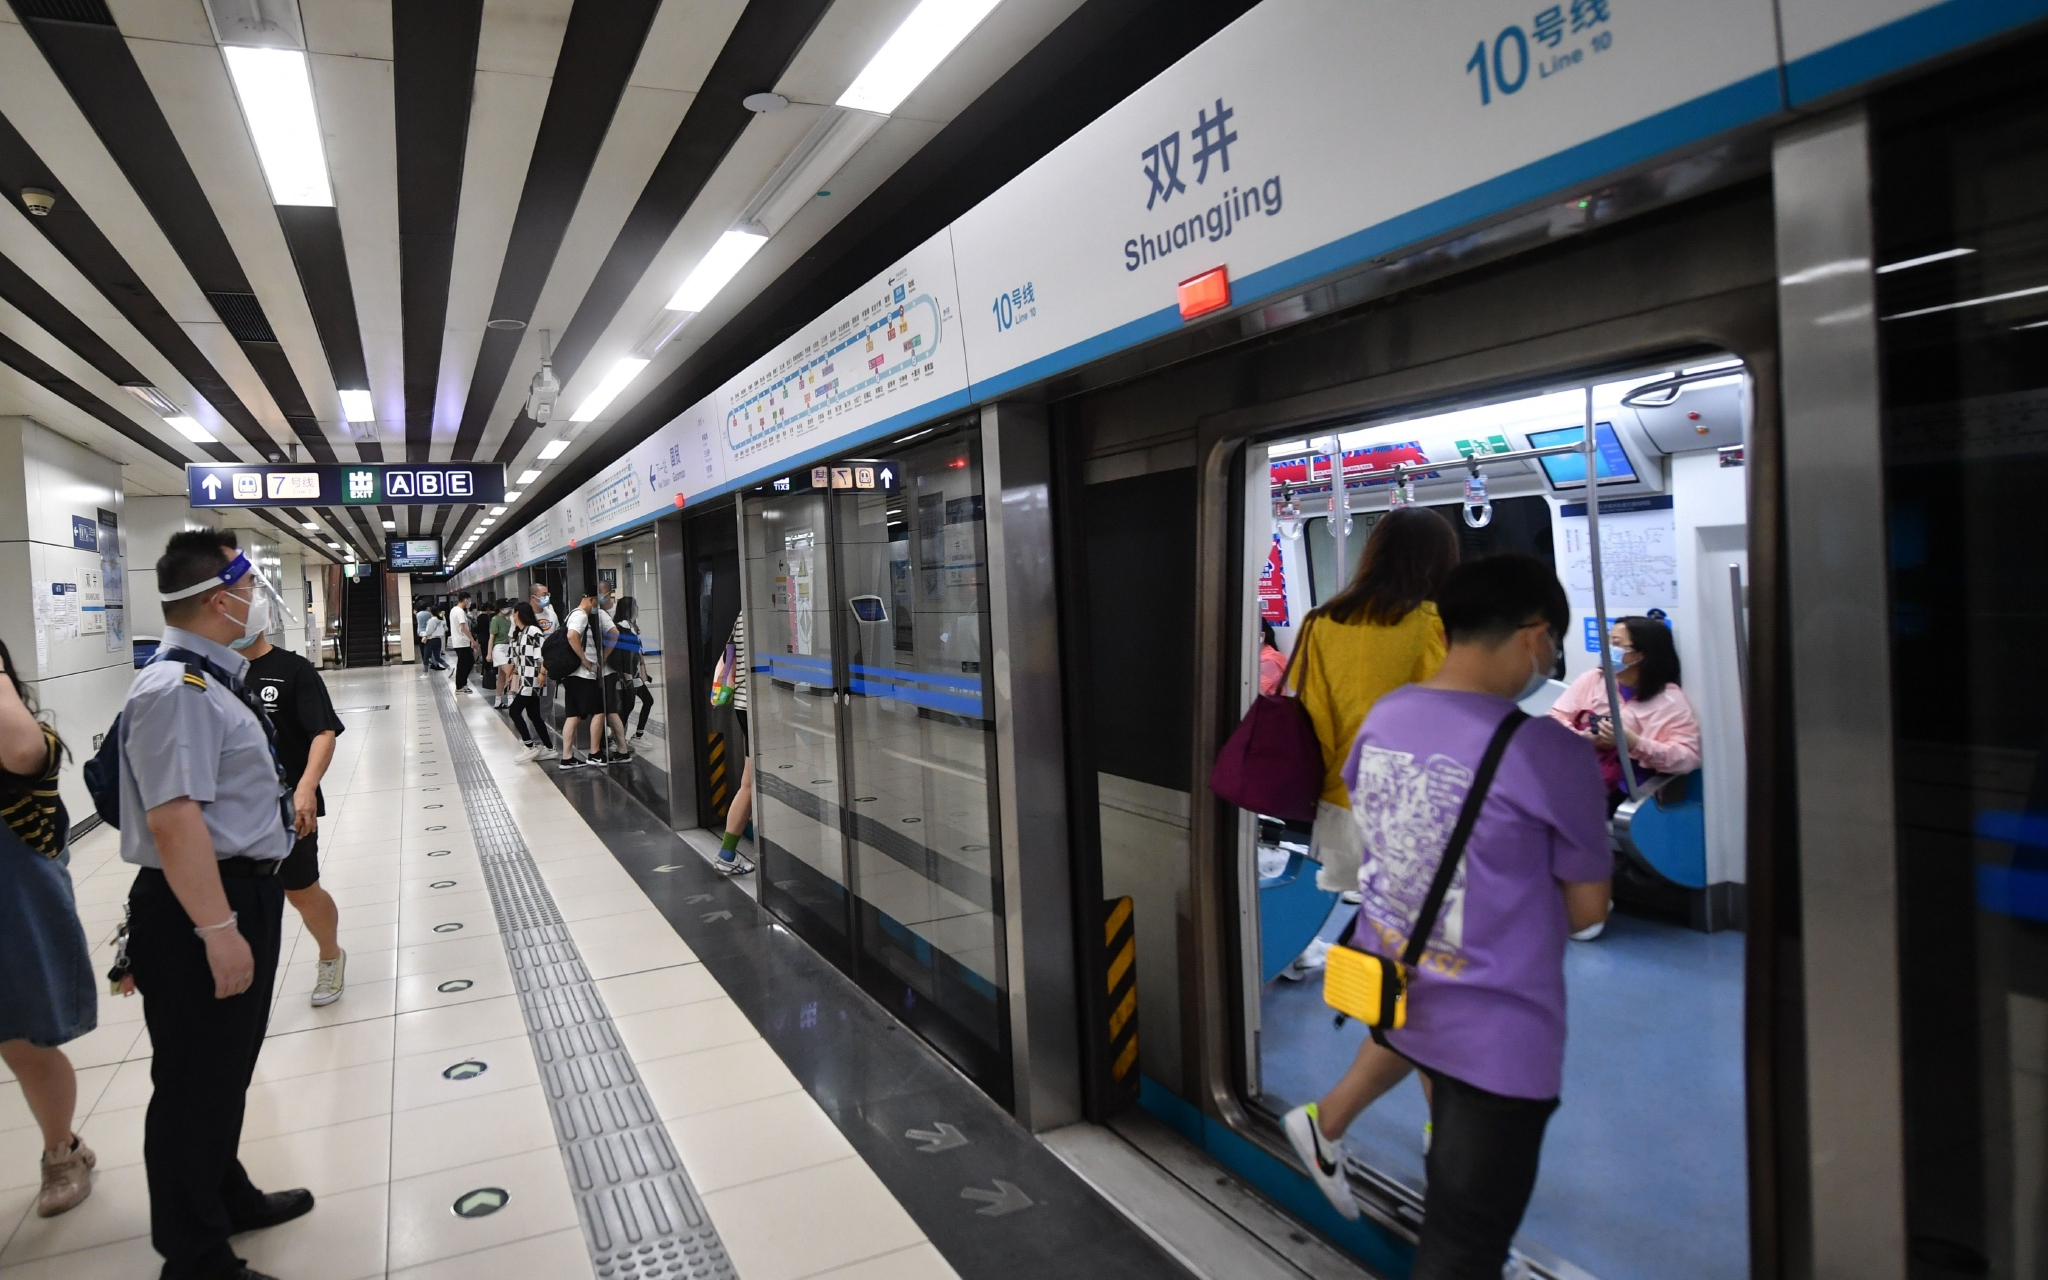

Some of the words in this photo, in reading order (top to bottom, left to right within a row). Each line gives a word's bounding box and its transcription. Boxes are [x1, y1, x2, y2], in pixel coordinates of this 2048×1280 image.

[1539, 48, 1584, 79] Line
[1591, 30, 1613, 54] 10
[1141, 97, 1238, 212] 双井
[1124, 174, 1283, 272] Shuangjing
[349, 490, 373, 499] EXIT
[391, 475, 410, 494] A
[422, 475, 438, 493] B
[451, 474, 468, 493] E
